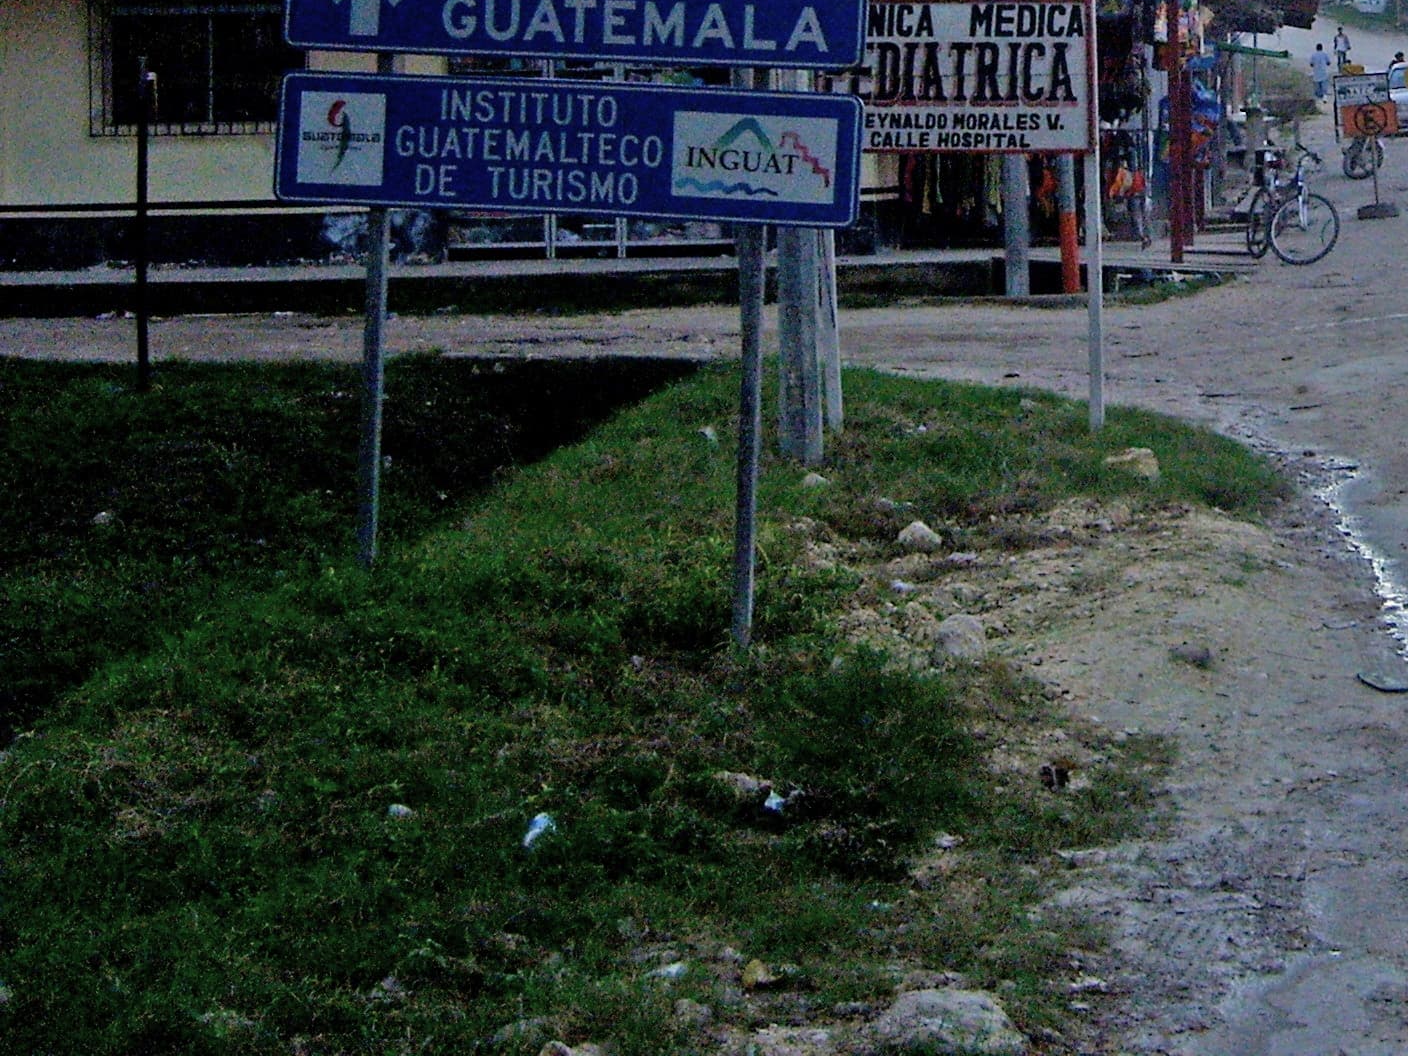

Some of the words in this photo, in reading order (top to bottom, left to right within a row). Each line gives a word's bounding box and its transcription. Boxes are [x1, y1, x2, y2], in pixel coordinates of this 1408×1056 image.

[969, 4, 1084, 38] MEDICA
[440, 89, 620, 128] INSTITUTO
[952, 113, 1041, 131] MORALES
[394, 125, 664, 169] GUATEMALTECO
[870, 131, 930, 148] CALLE
[937, 132, 1031, 149] HOSPITAL
[686, 145, 800, 176] INGUAT
[414, 165, 455, 198] DE
[487, 167, 640, 205] TURISMO
